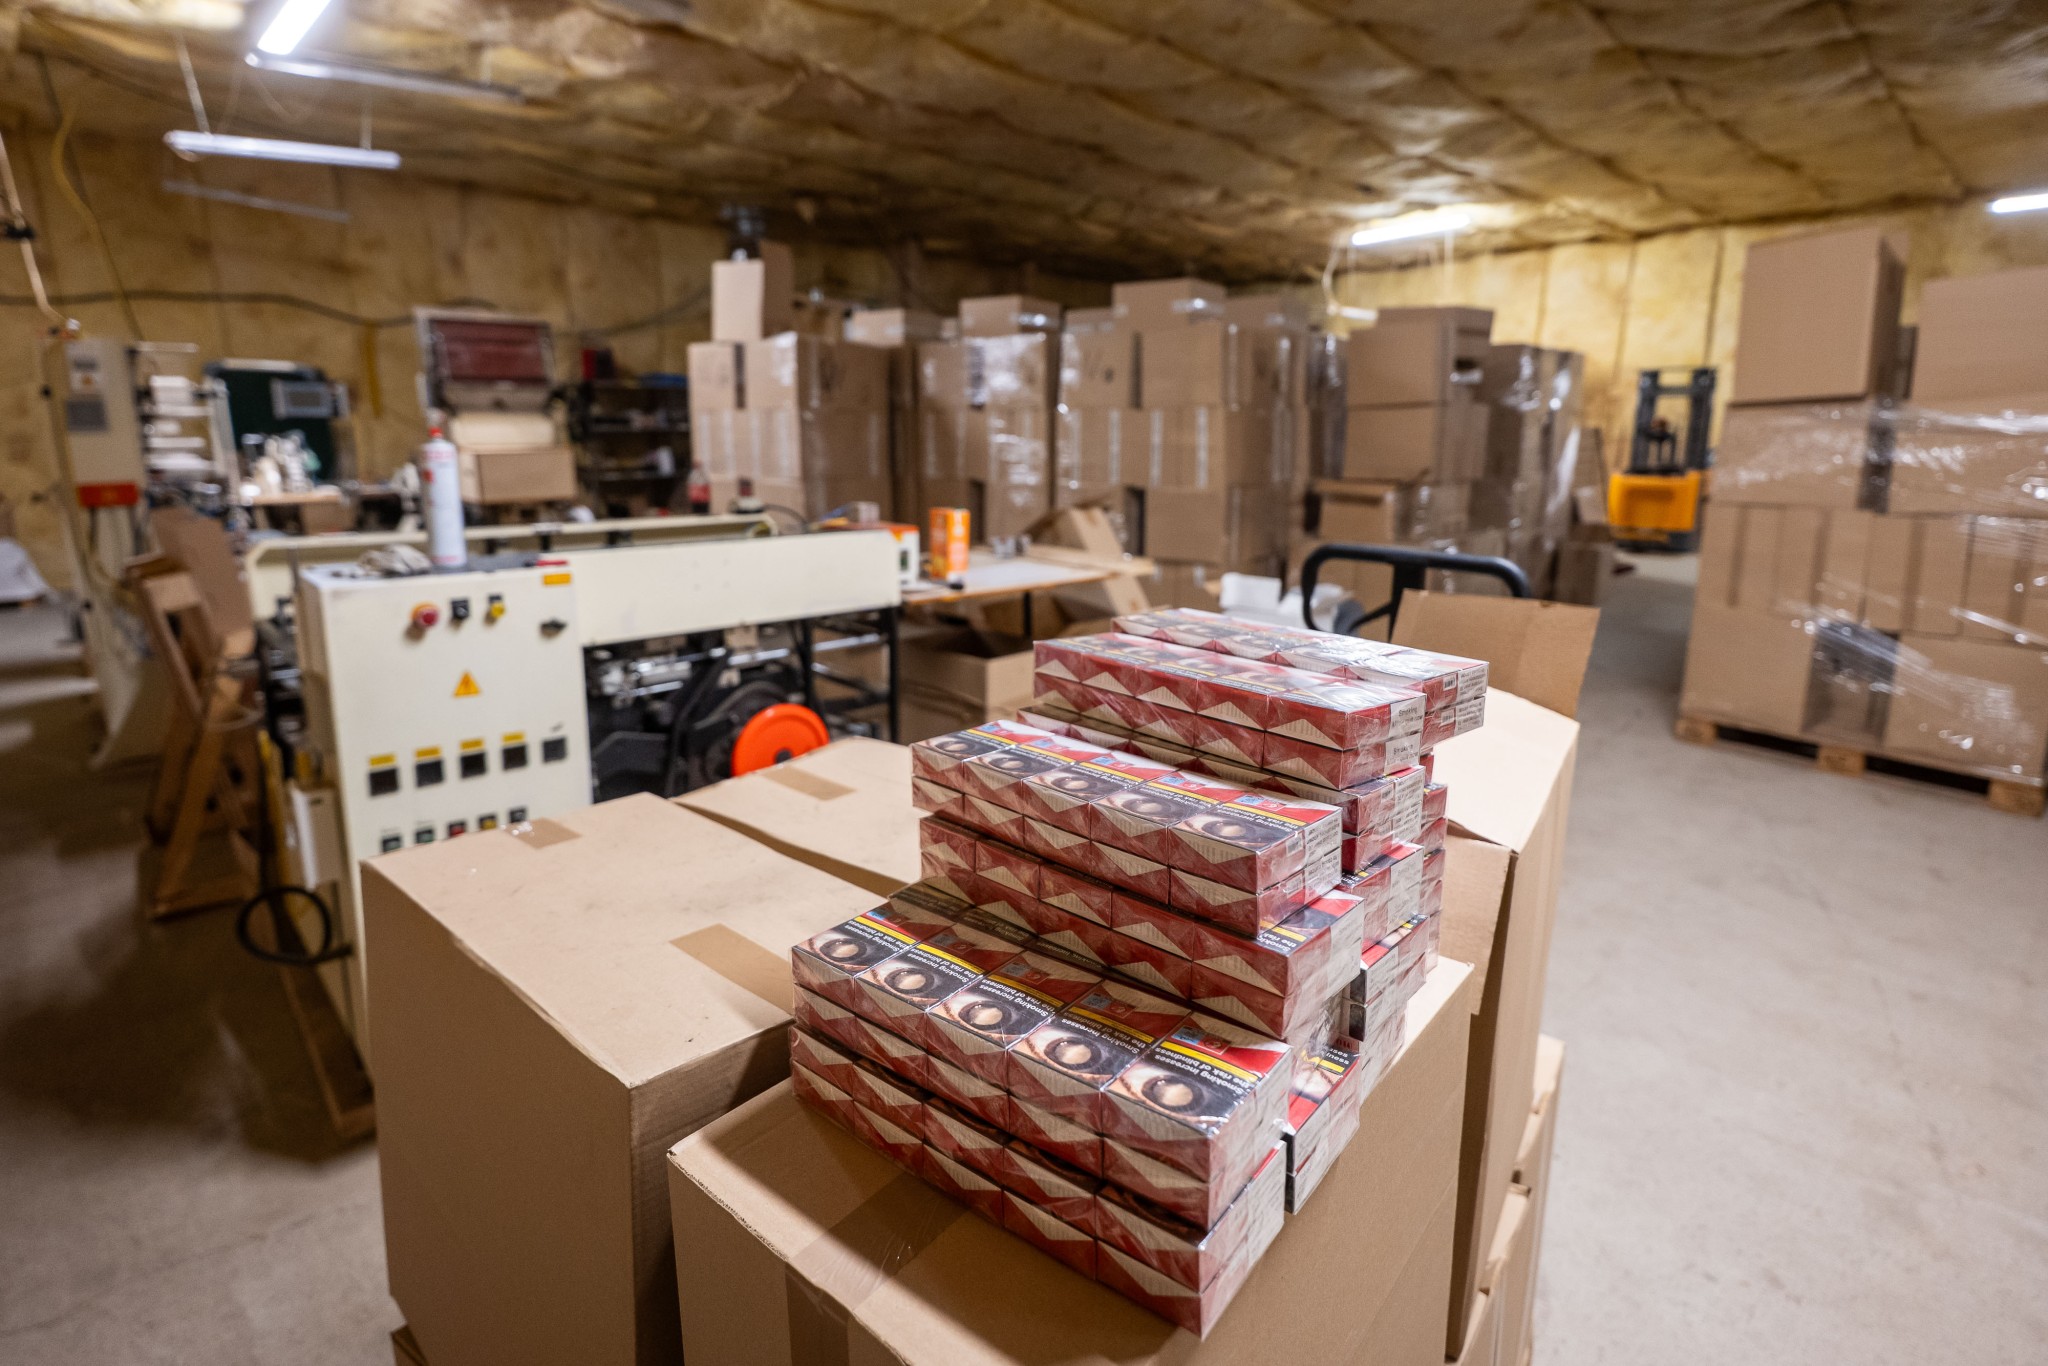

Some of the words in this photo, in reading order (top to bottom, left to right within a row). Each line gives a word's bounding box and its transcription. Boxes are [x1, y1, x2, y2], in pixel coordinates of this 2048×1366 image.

[1256, 819, 1293, 832] Smoking
[1281, 939, 1297, 948] the
[907, 953, 940, 969] increases
[911, 948, 943, 963] blindness
[939, 965, 969, 983] Smoking
[950, 963, 964, 972] risk
[964, 971, 976, 979] the
[979, 984, 1015, 1001] increases
[982, 979, 1017, 994] blindness
[1014, 997, 1049, 1017] Smoking
[1026, 996, 1042, 1005] risk
[1042, 1003, 1056, 1013] the
[1061, 1018, 1100, 1037] increases
[1064, 1012, 1103, 1031] blindness
[1101, 1034, 1140, 1054] Smoking
[1113, 1031, 1133, 1043] risk
[1131, 1039, 1146, 1049] the
[1155, 1047, 1200, 1067] blindness
[1155, 1054, 1200, 1076] increases
[1199, 1063, 1213, 1071] of
[1212, 1068, 1232, 1080] risk
[1200, 1071, 1245, 1095] Smoking
[1231, 1077, 1251, 1089] the
